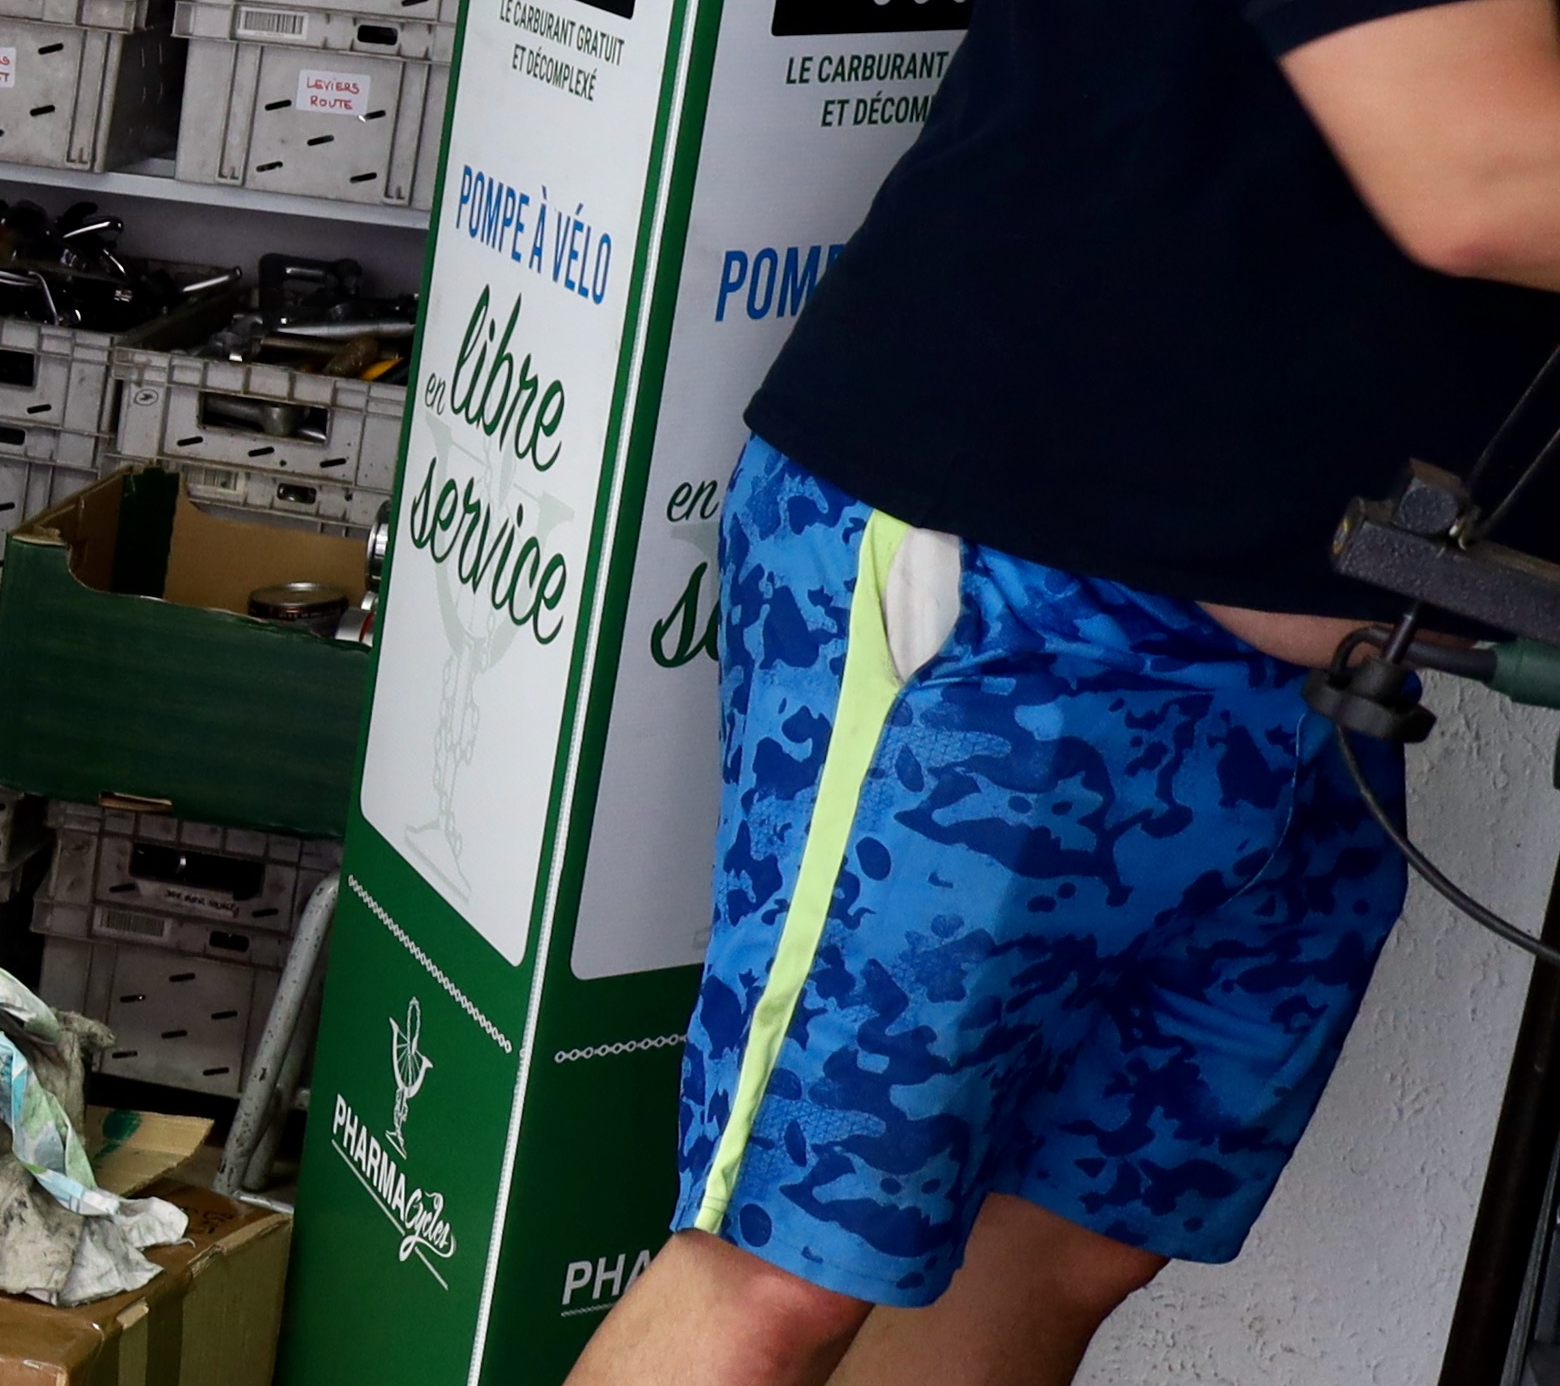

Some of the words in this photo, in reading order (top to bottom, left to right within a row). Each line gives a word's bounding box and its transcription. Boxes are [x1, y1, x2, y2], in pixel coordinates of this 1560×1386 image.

[513, 0, 576, 47] CARBURANT
[576, 24, 626, 66] GRATUIT
[306, 76, 360, 94] LEVIERS
[512, 43, 527, 72] ET
[526, 46, 598, 101] DÉCOMPLEXÉ
[786, 56, 813, 84] LE
[817, 51, 950, 83] CARBURANT
[310, 95, 353, 110] ROUTE
[821, 99, 850, 127] ET
[852, 90, 935, 126] DÉCOM
[456, 164, 530, 264] POMPE
[529, 184, 549, 275] À
[552, 203, 613, 305] VÉLO
[425, 370, 447, 417] en
[451, 283, 566, 472] libre
[666, 479, 719, 523] en
[410, 456, 568, 646] service
